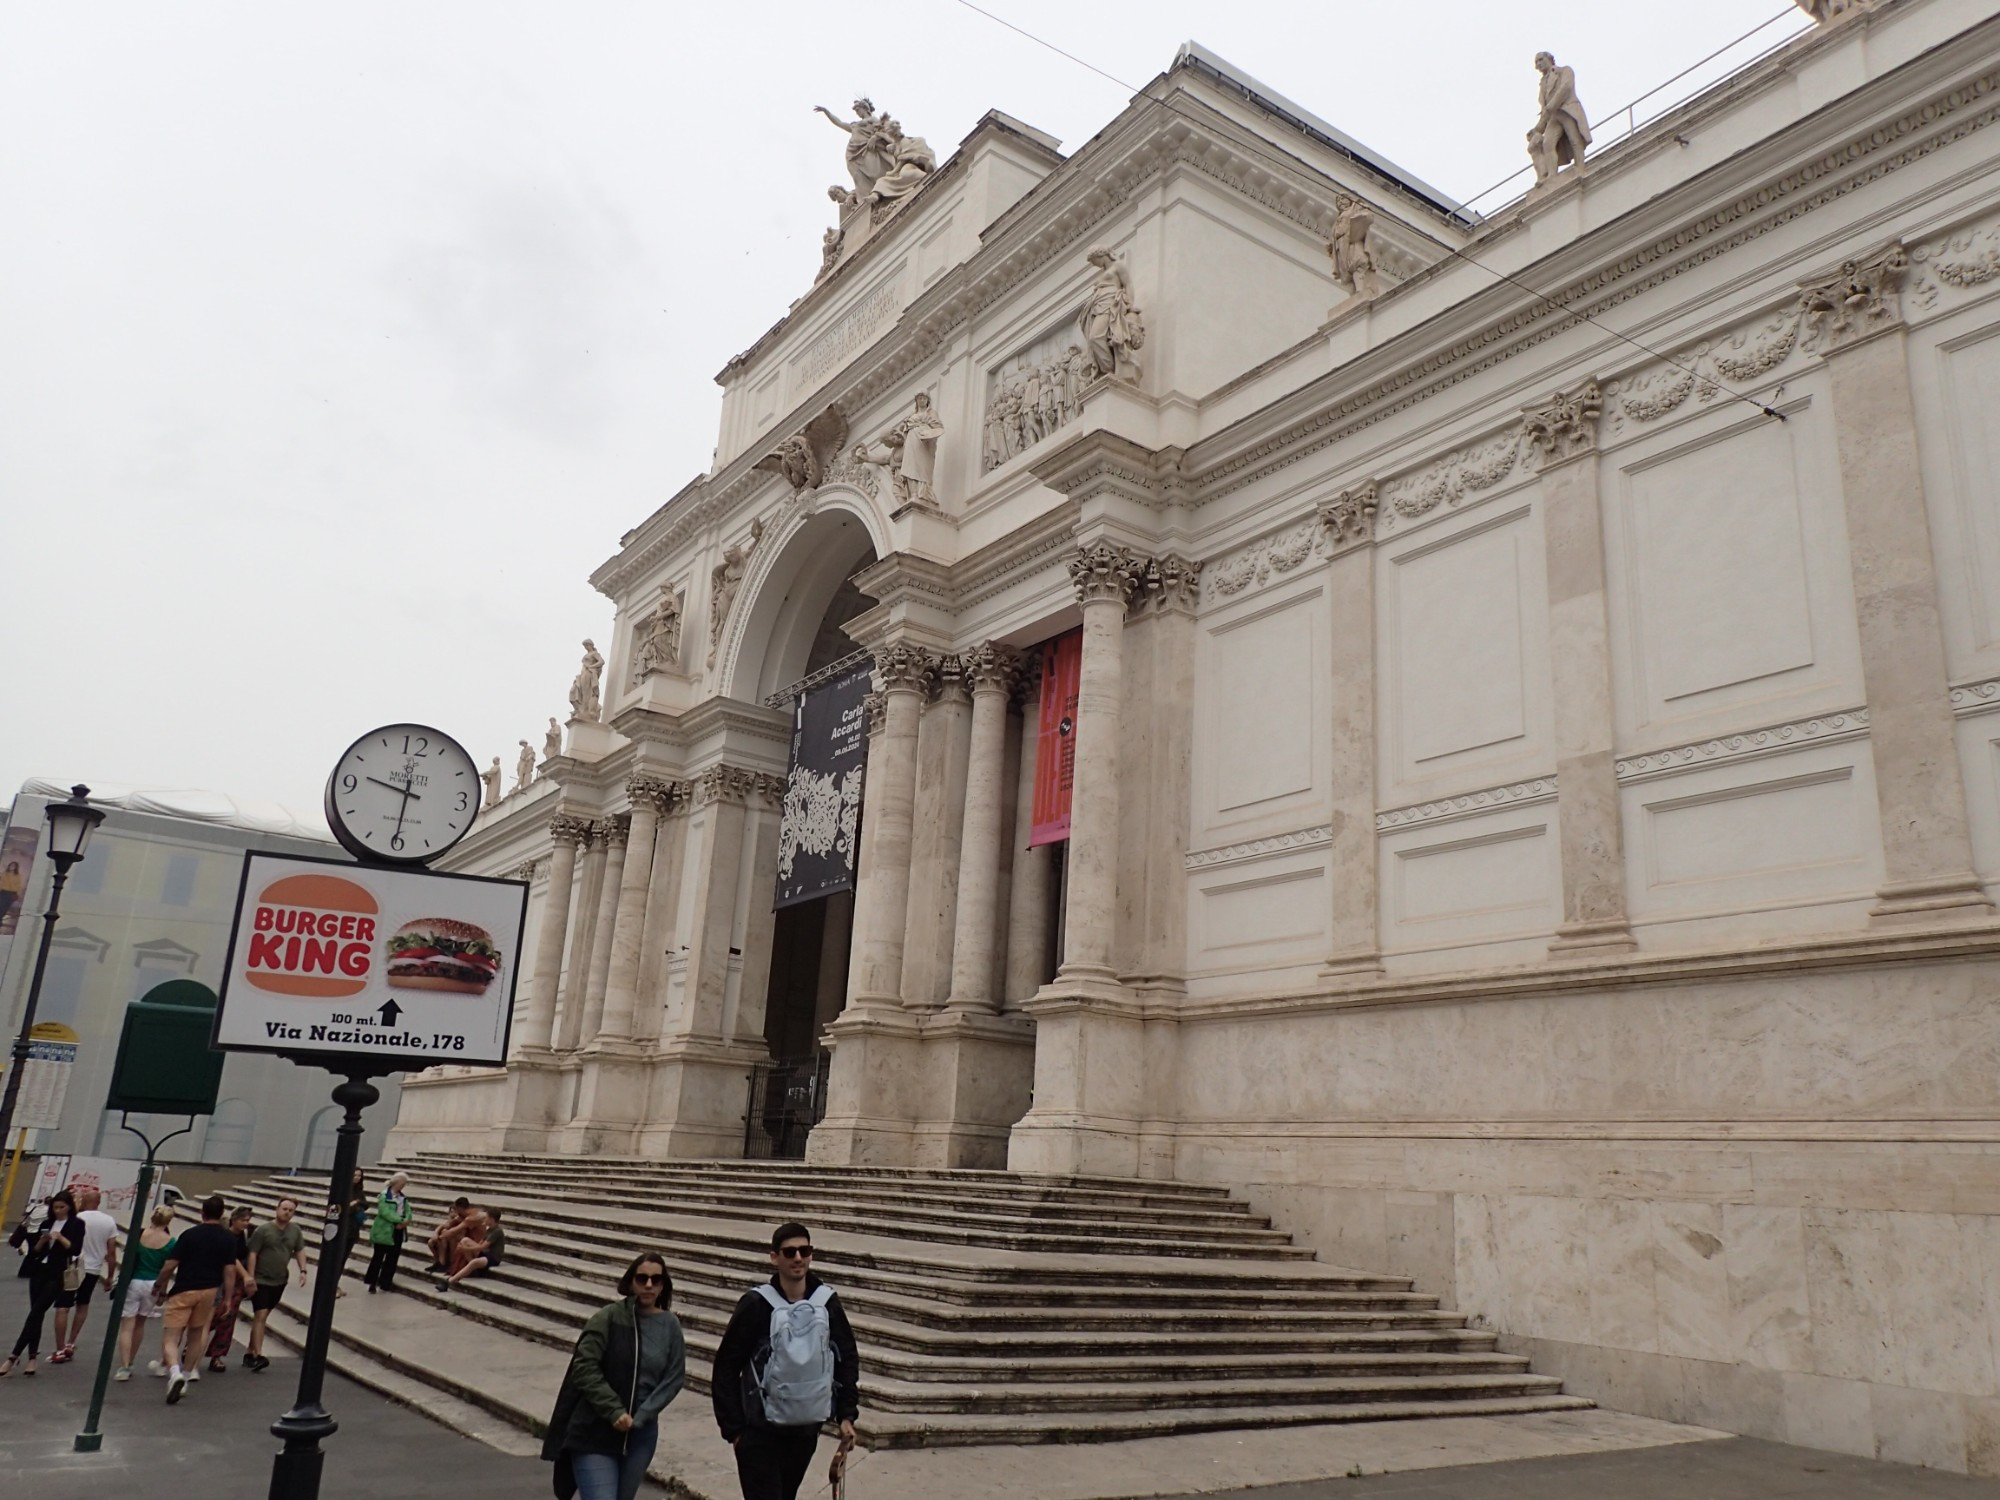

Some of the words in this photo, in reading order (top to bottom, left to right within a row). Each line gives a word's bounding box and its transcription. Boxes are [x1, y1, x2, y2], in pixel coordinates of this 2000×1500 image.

[842, 704, 864, 722] Carla
[830, 716, 863, 741] Accardi
[401, 735, 428, 757] 12
[341, 774, 358, 795] 9
[390, 771, 428, 782] MORETTI
[454, 791, 468, 812] 3
[390, 831, 405, 852] 6
[254, 906, 376, 942] BURGER
[247, 932, 371, 977] KING
[331, 1013, 352, 1024] 100
[356, 1016, 377, 1026] mt.
[265, 1022, 302, 1039] Via
